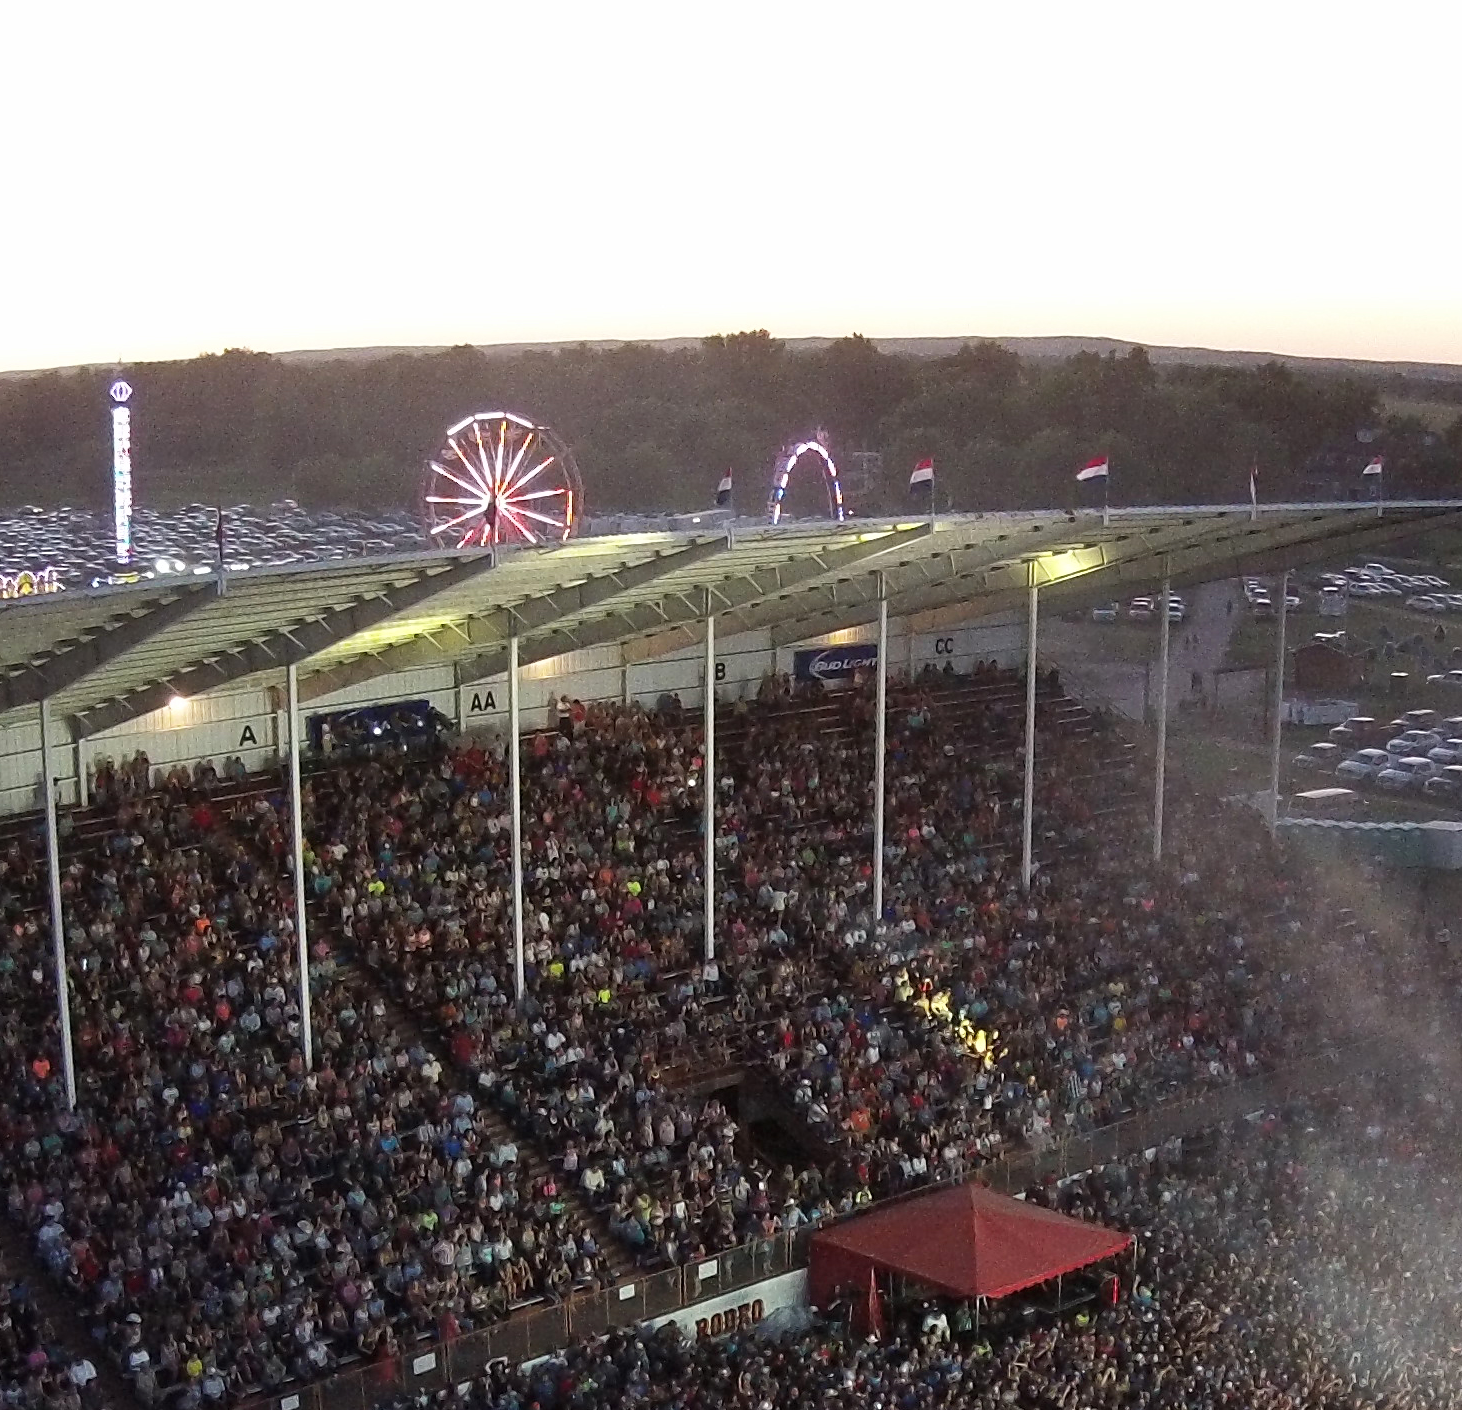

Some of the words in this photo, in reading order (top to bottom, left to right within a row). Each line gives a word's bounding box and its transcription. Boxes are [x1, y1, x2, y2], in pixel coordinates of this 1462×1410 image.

[935, 638, 953, 654] CC
[470, 691, 496, 712] AA
[239, 725, 257, 746] A
